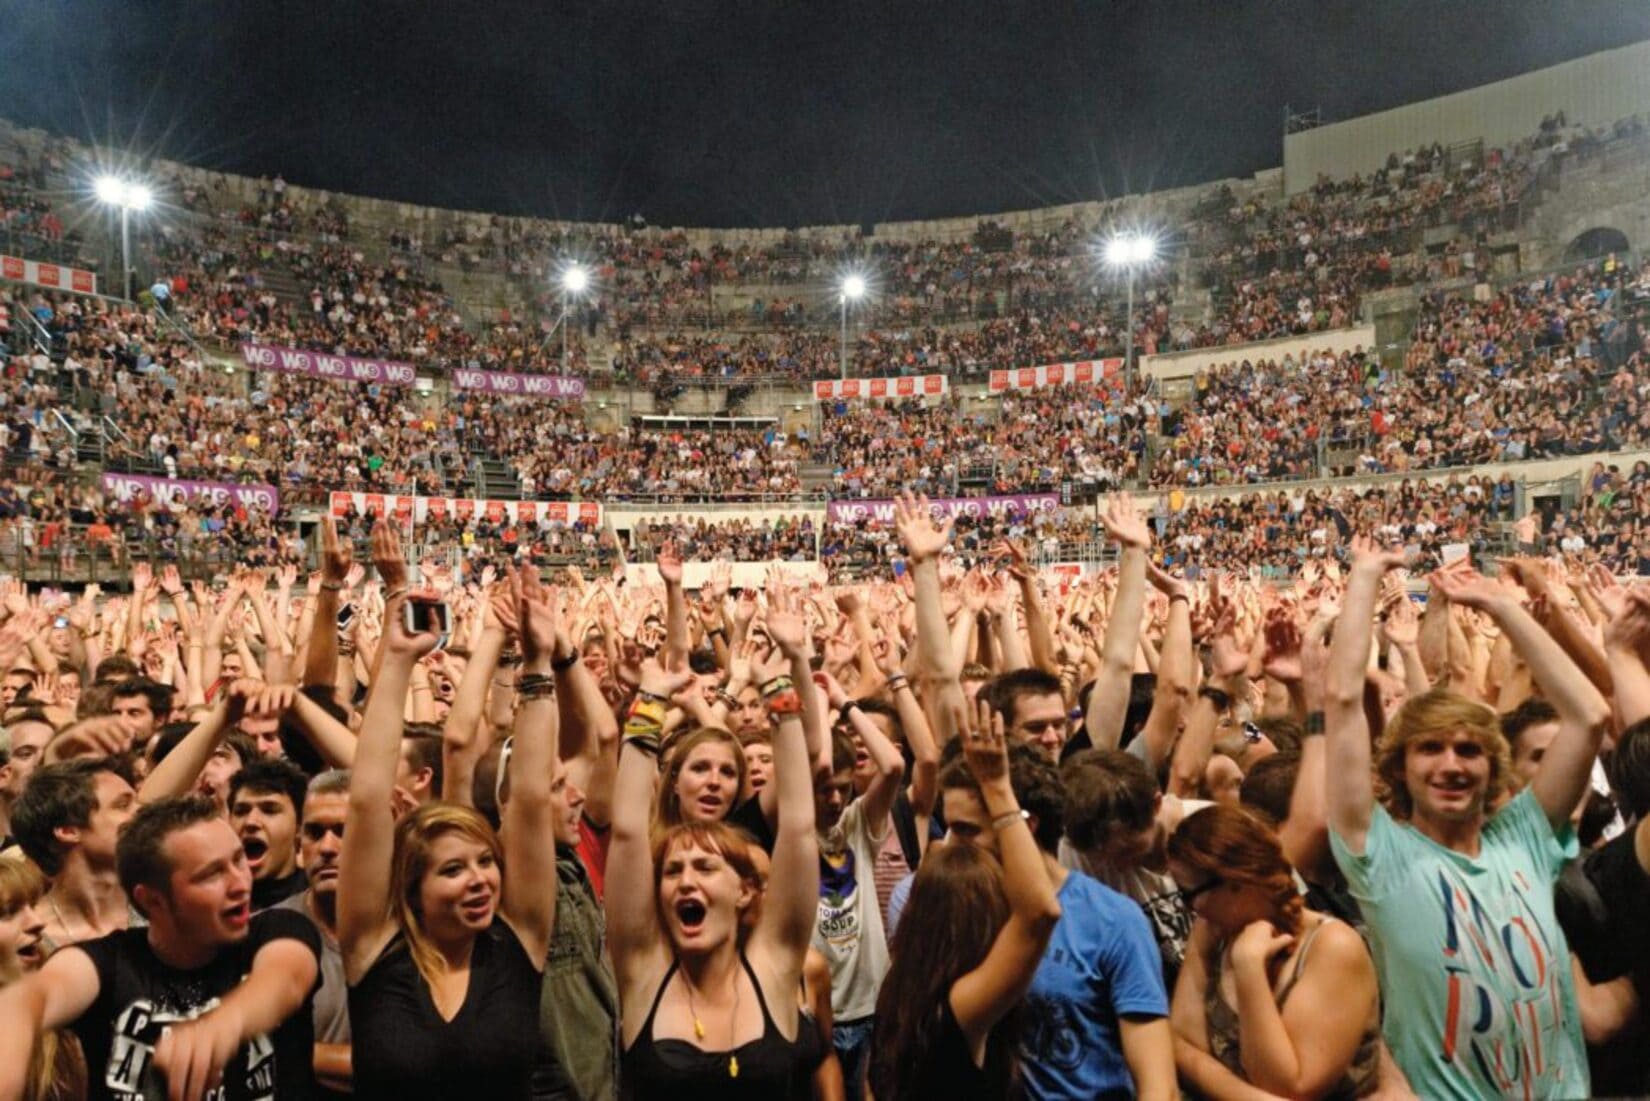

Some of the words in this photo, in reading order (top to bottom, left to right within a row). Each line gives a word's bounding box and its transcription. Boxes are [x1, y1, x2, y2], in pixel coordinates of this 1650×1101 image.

[243, 346, 276, 365] W9
[280, 351, 310, 370] W9
[315, 355, 346, 375] W9
[351, 360, 380, 379] W9
[385, 365, 414, 383] W9
[822, 916, 854, 931] SOUP
